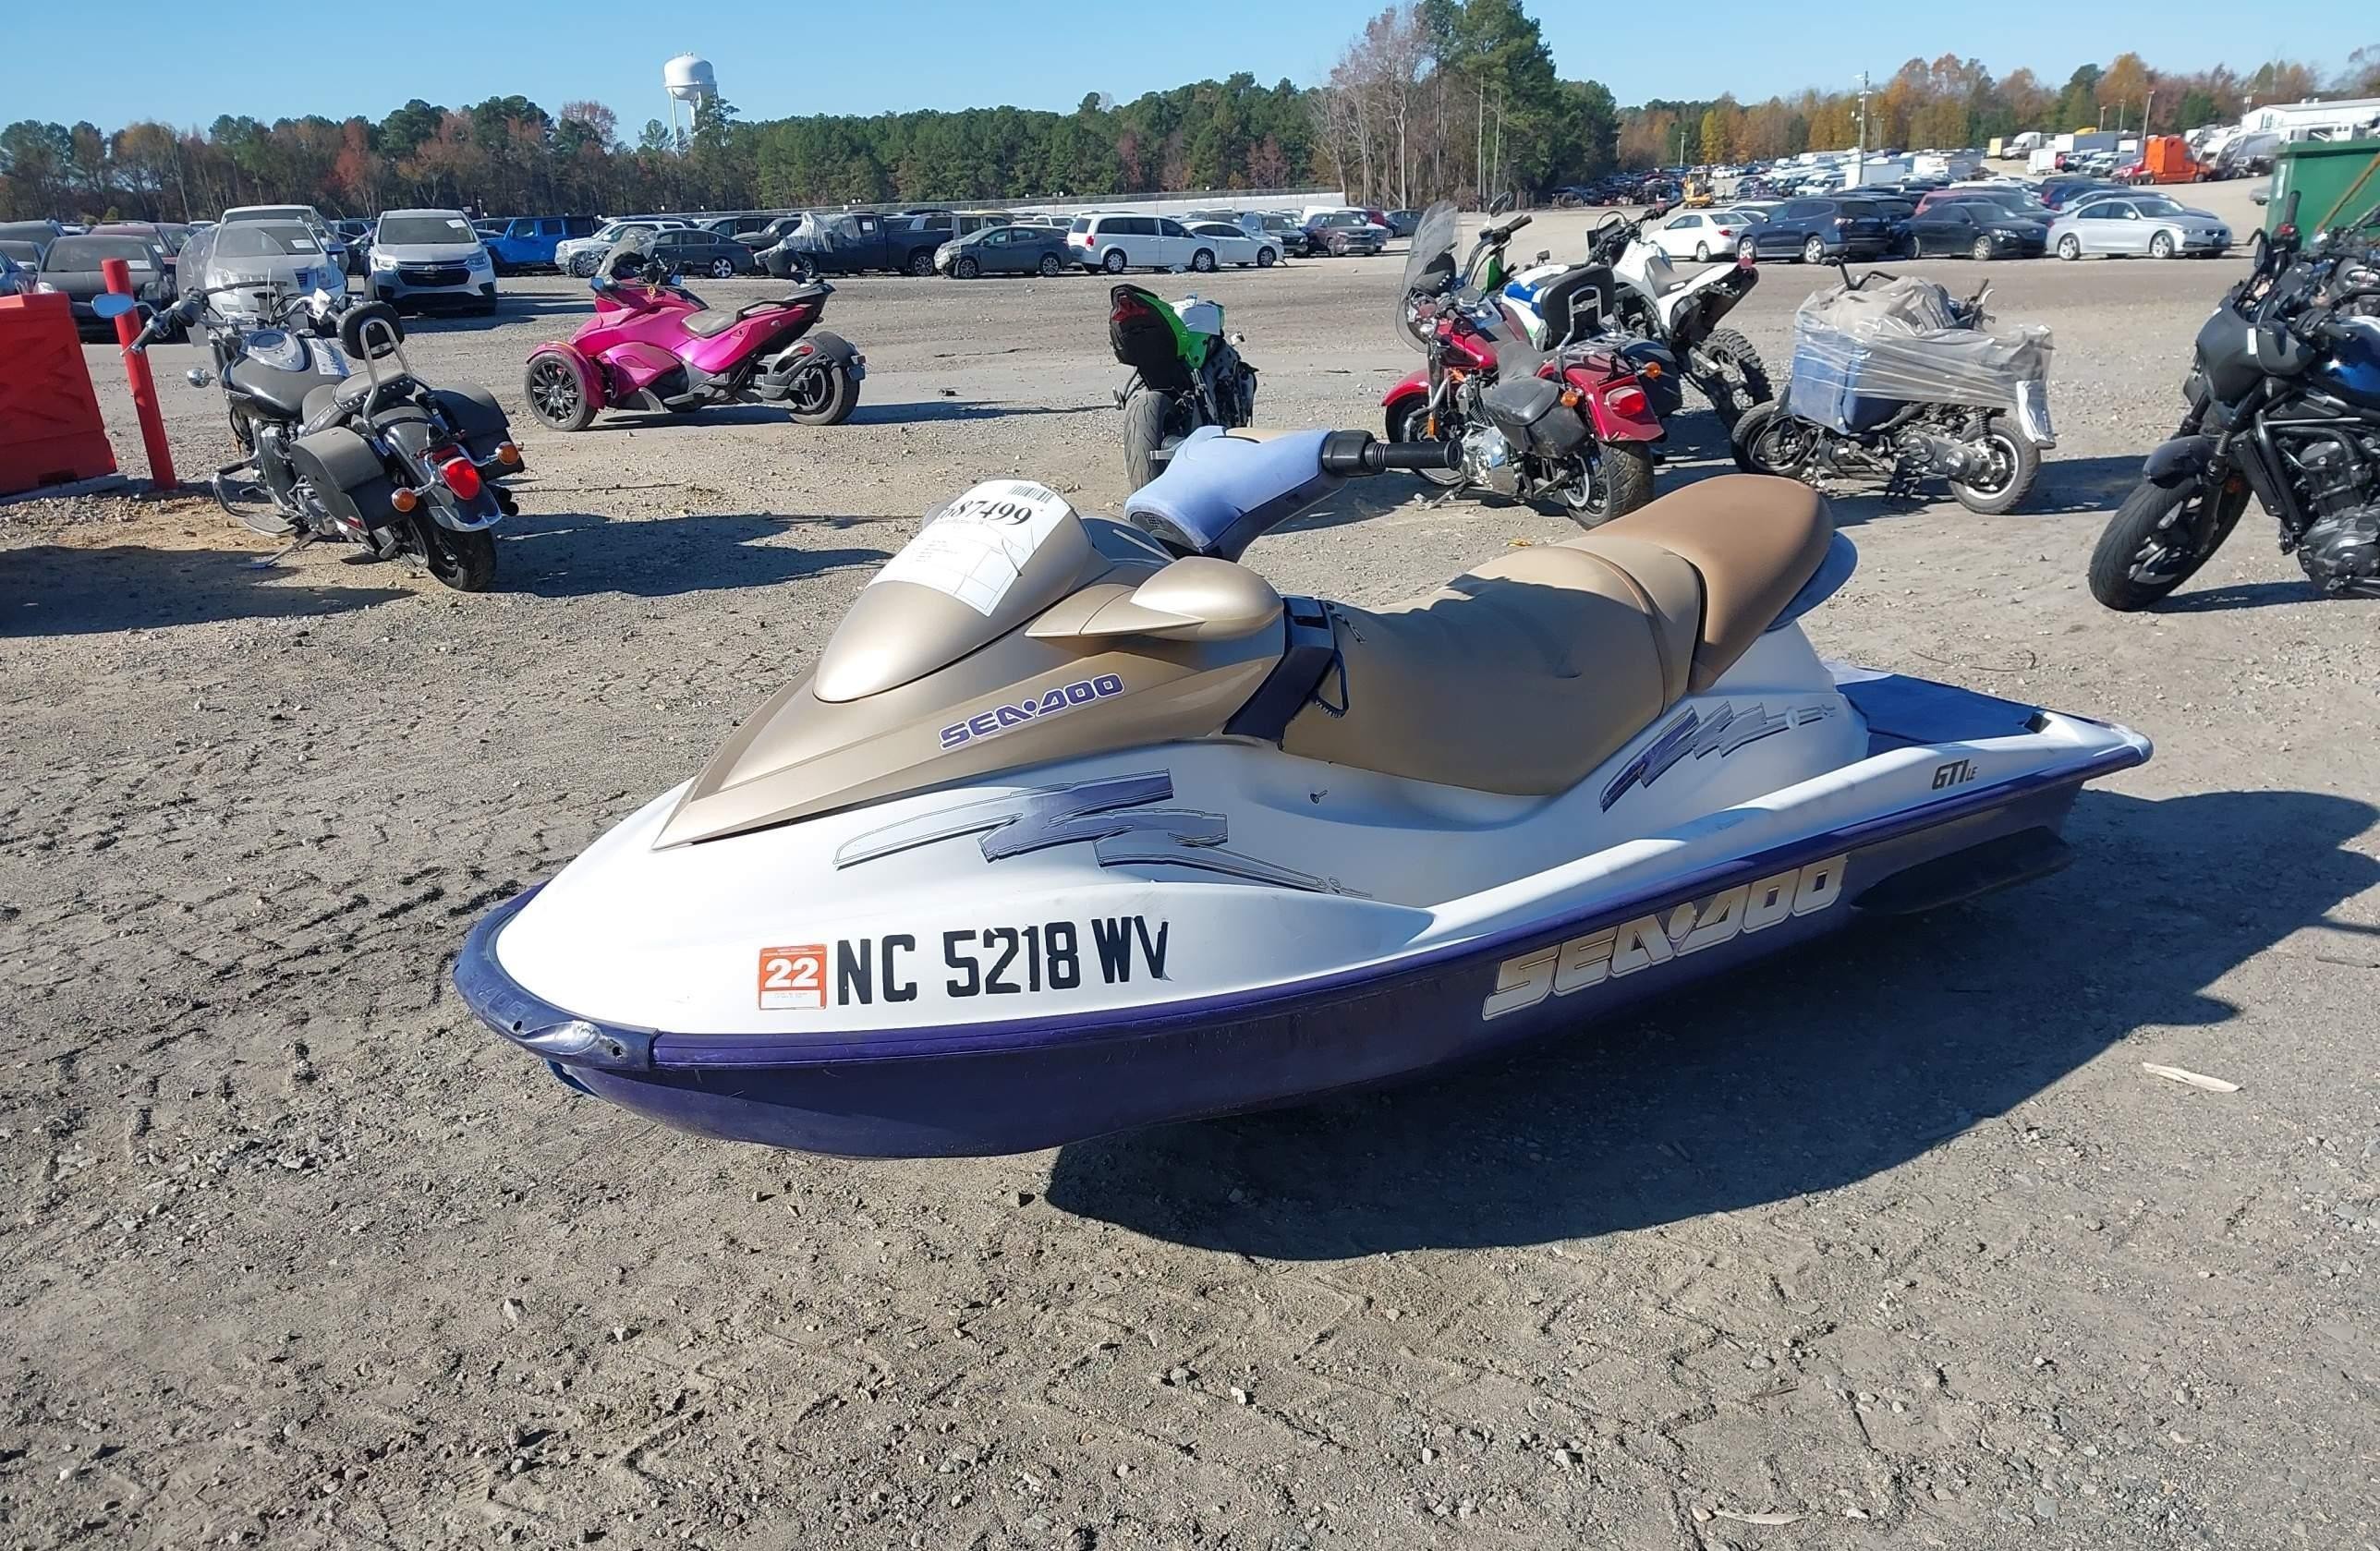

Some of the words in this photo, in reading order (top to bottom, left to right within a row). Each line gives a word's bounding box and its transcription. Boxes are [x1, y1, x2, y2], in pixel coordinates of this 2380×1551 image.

[764, 957, 819, 988] 22
[837, 934, 917, 1005] NC
[942, 921, 1081, 998] 5218
[1090, 915, 1172, 984] WV
